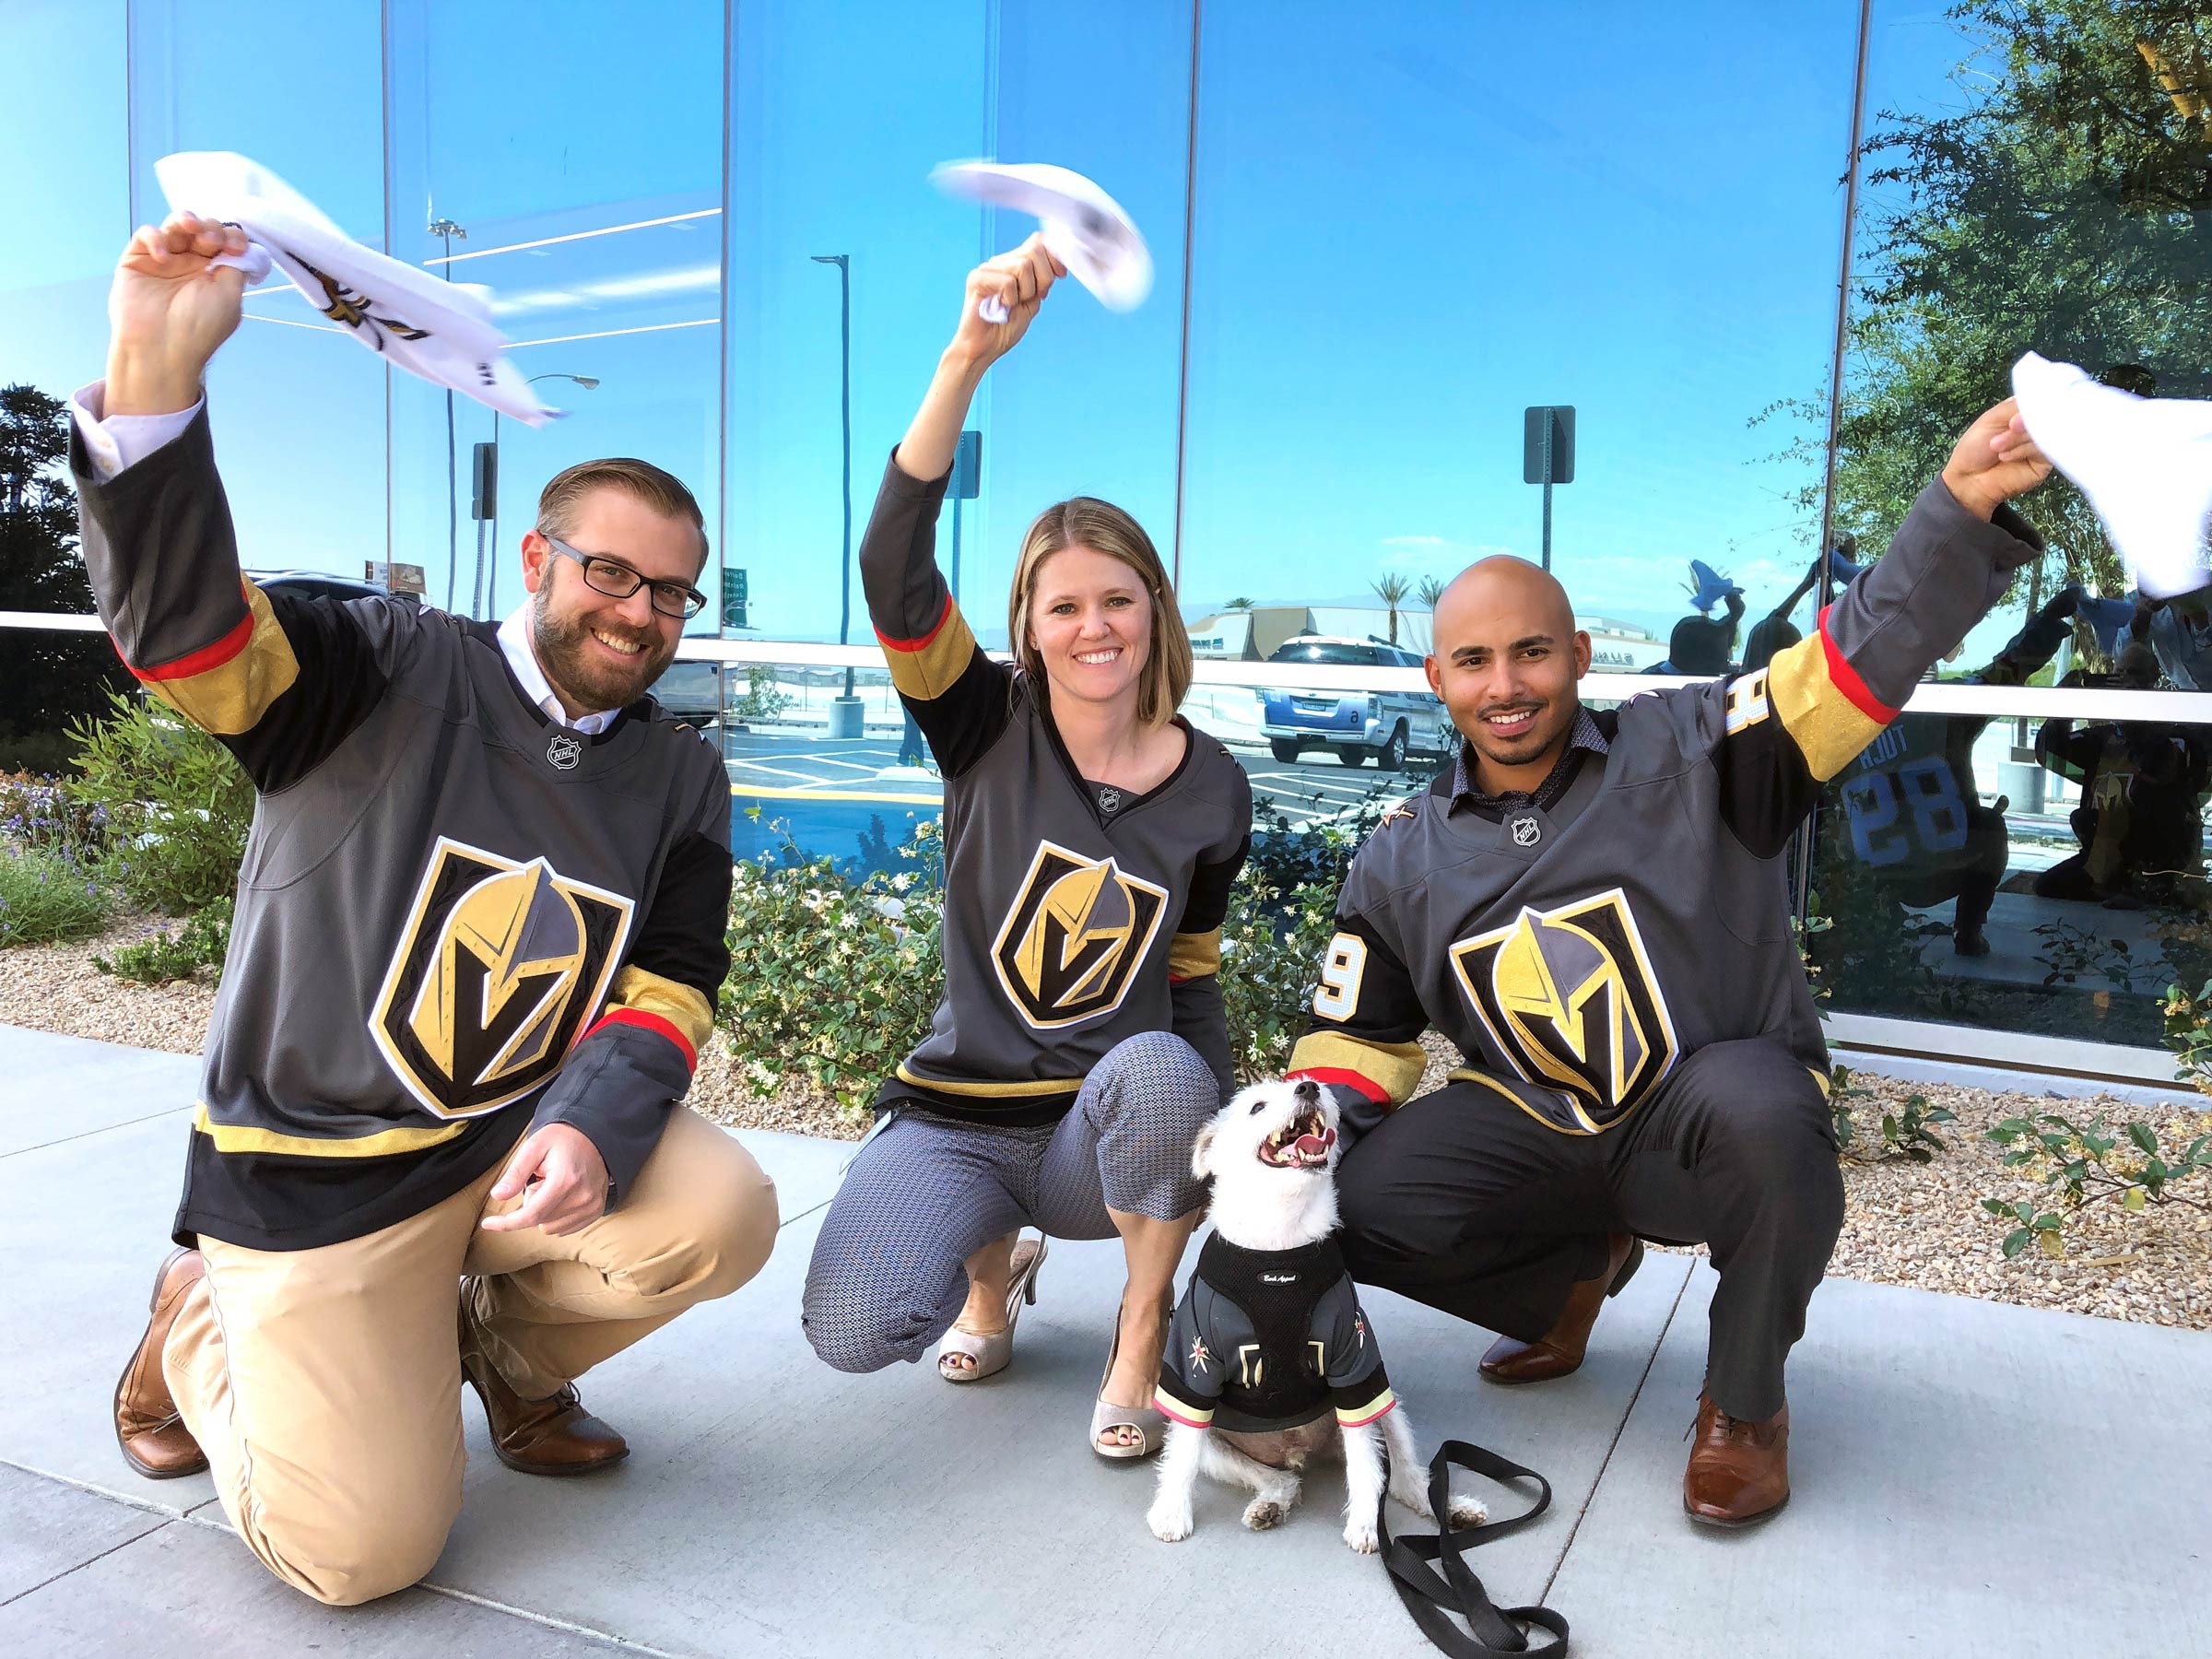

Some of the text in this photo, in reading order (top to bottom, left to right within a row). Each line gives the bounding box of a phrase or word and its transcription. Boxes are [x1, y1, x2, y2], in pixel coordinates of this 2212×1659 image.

[554, 747, 574, 759] NHL
[1103, 797, 1116, 806] NHL
[1519, 824, 1534, 841] NHL
[1312, 931, 1369, 1023] 9
